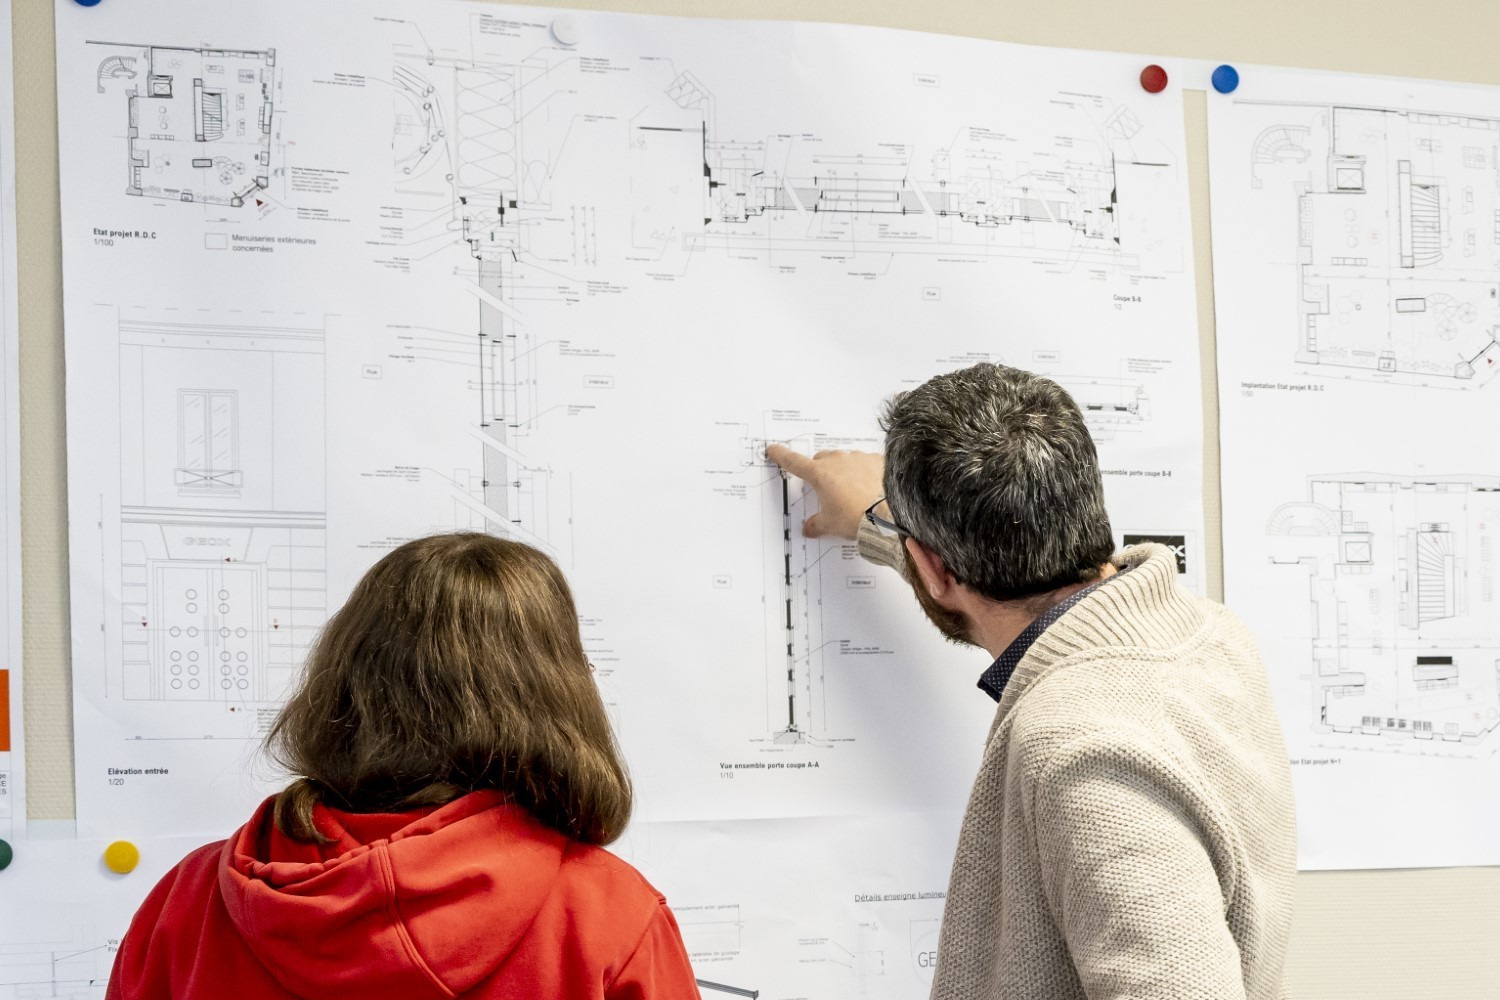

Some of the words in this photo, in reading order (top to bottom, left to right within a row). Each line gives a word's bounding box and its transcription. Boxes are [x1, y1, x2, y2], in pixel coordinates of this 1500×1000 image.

[93, 228, 108, 238] Etat
[110, 230, 132, 240] projet
[134, 230, 157, 240] R.D.C
[94, 238, 114, 247] 1/100
[232, 234, 275, 244] Menuiseries
[276, 235, 316, 246] extérieures
[232, 244, 274, 254] concernées
[1113, 294, 1130, 304] Coupe
[1276, 382, 1288, 390] Etat
[1288, 383, 1306, 392] projet
[182, 537, 232, 547] GEOX
[108, 766, 142, 776] Elévation
[144, 766, 169, 776] entrée
[720, 762, 733, 770] Vue
[734, 762, 766, 770] ensemble
[767, 762, 784, 772] porte
[786, 762, 805, 771] coupe
[720, 772, 734, 780] 1/10
[108, 778, 124, 786] 1/20
[854, 893, 882, 902] Détails
[884, 892, 916, 901] enseigne
